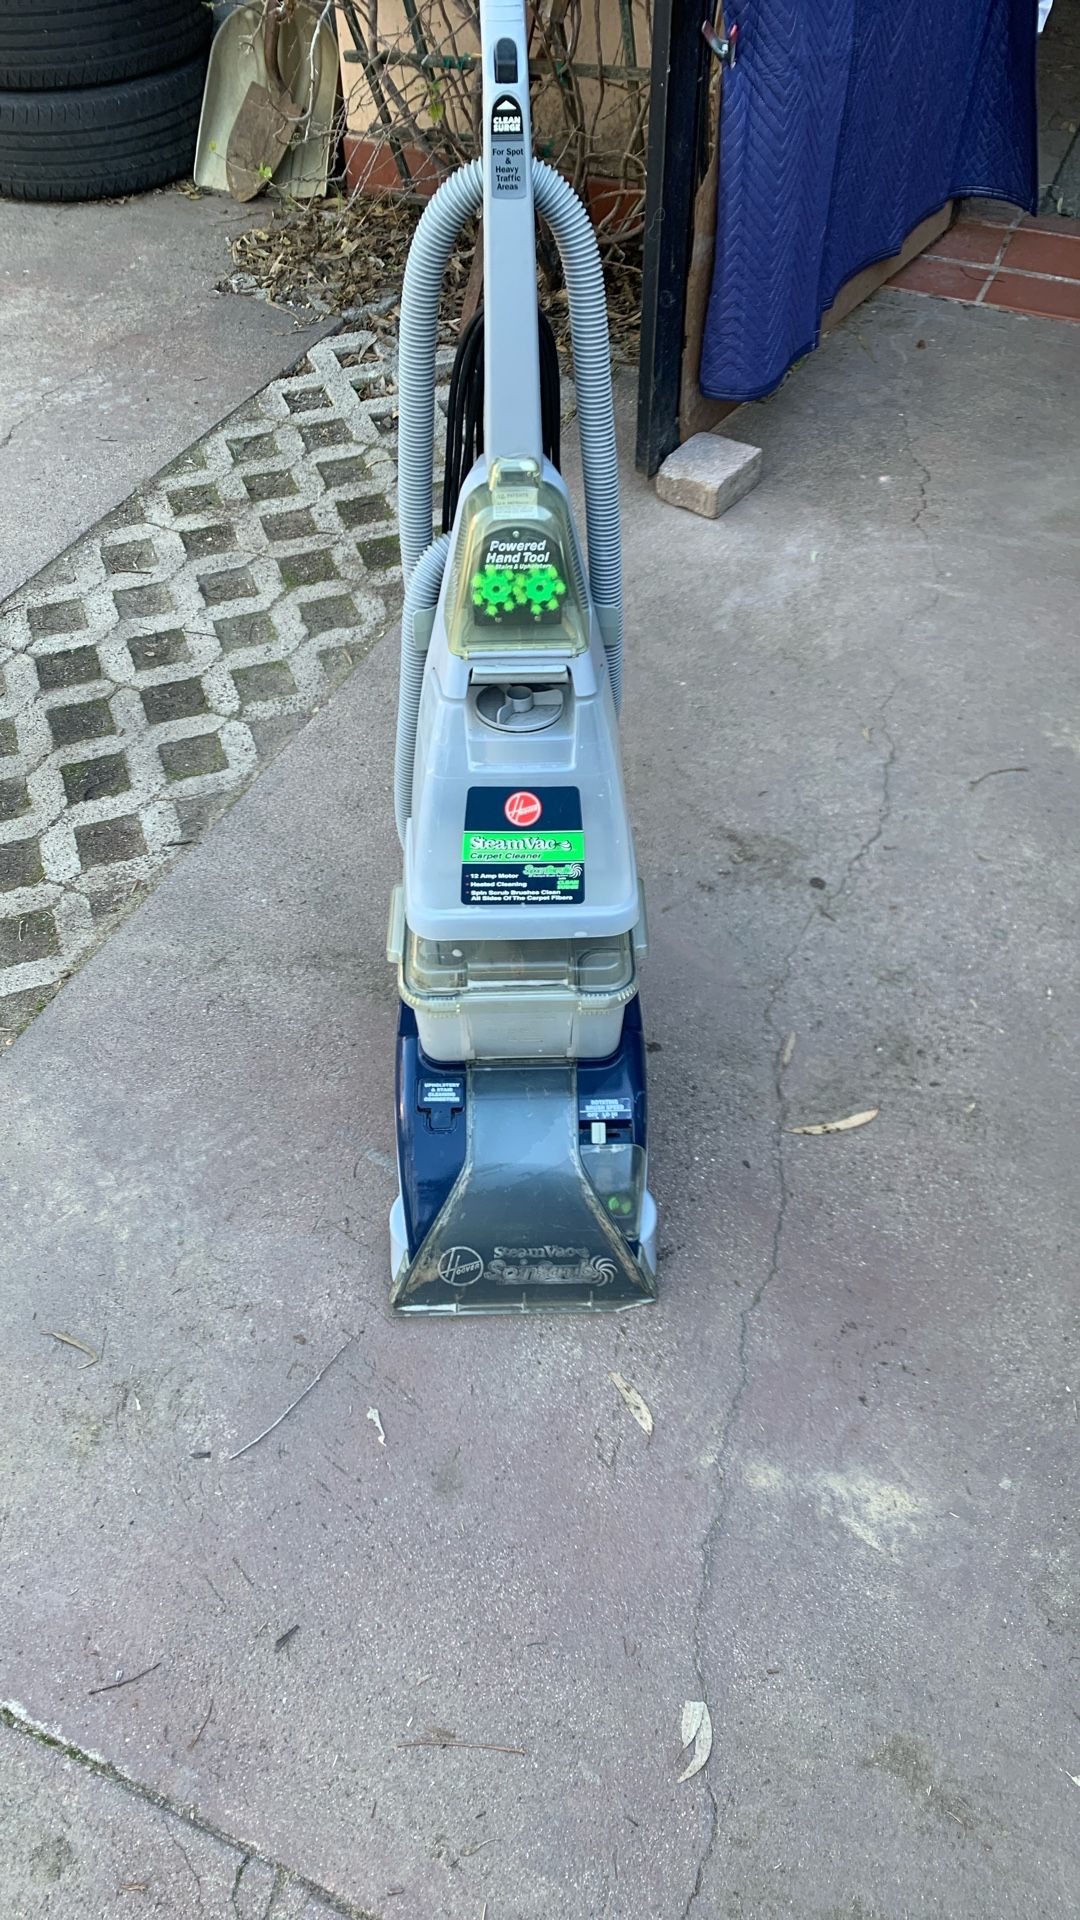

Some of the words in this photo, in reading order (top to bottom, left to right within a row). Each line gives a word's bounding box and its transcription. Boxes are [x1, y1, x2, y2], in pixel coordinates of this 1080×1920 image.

[493, 116, 520, 124] CLEAN
[493, 124, 520, 132] SURGE
[506, 149, 523, 157] Spot
[489, 540, 546, 551] Powered
[486, 552, 520, 563] Hand
[522, 552, 550, 563] Tool
[469, 836, 556, 851] SteamVac
[470, 852, 502, 860] Carpet
